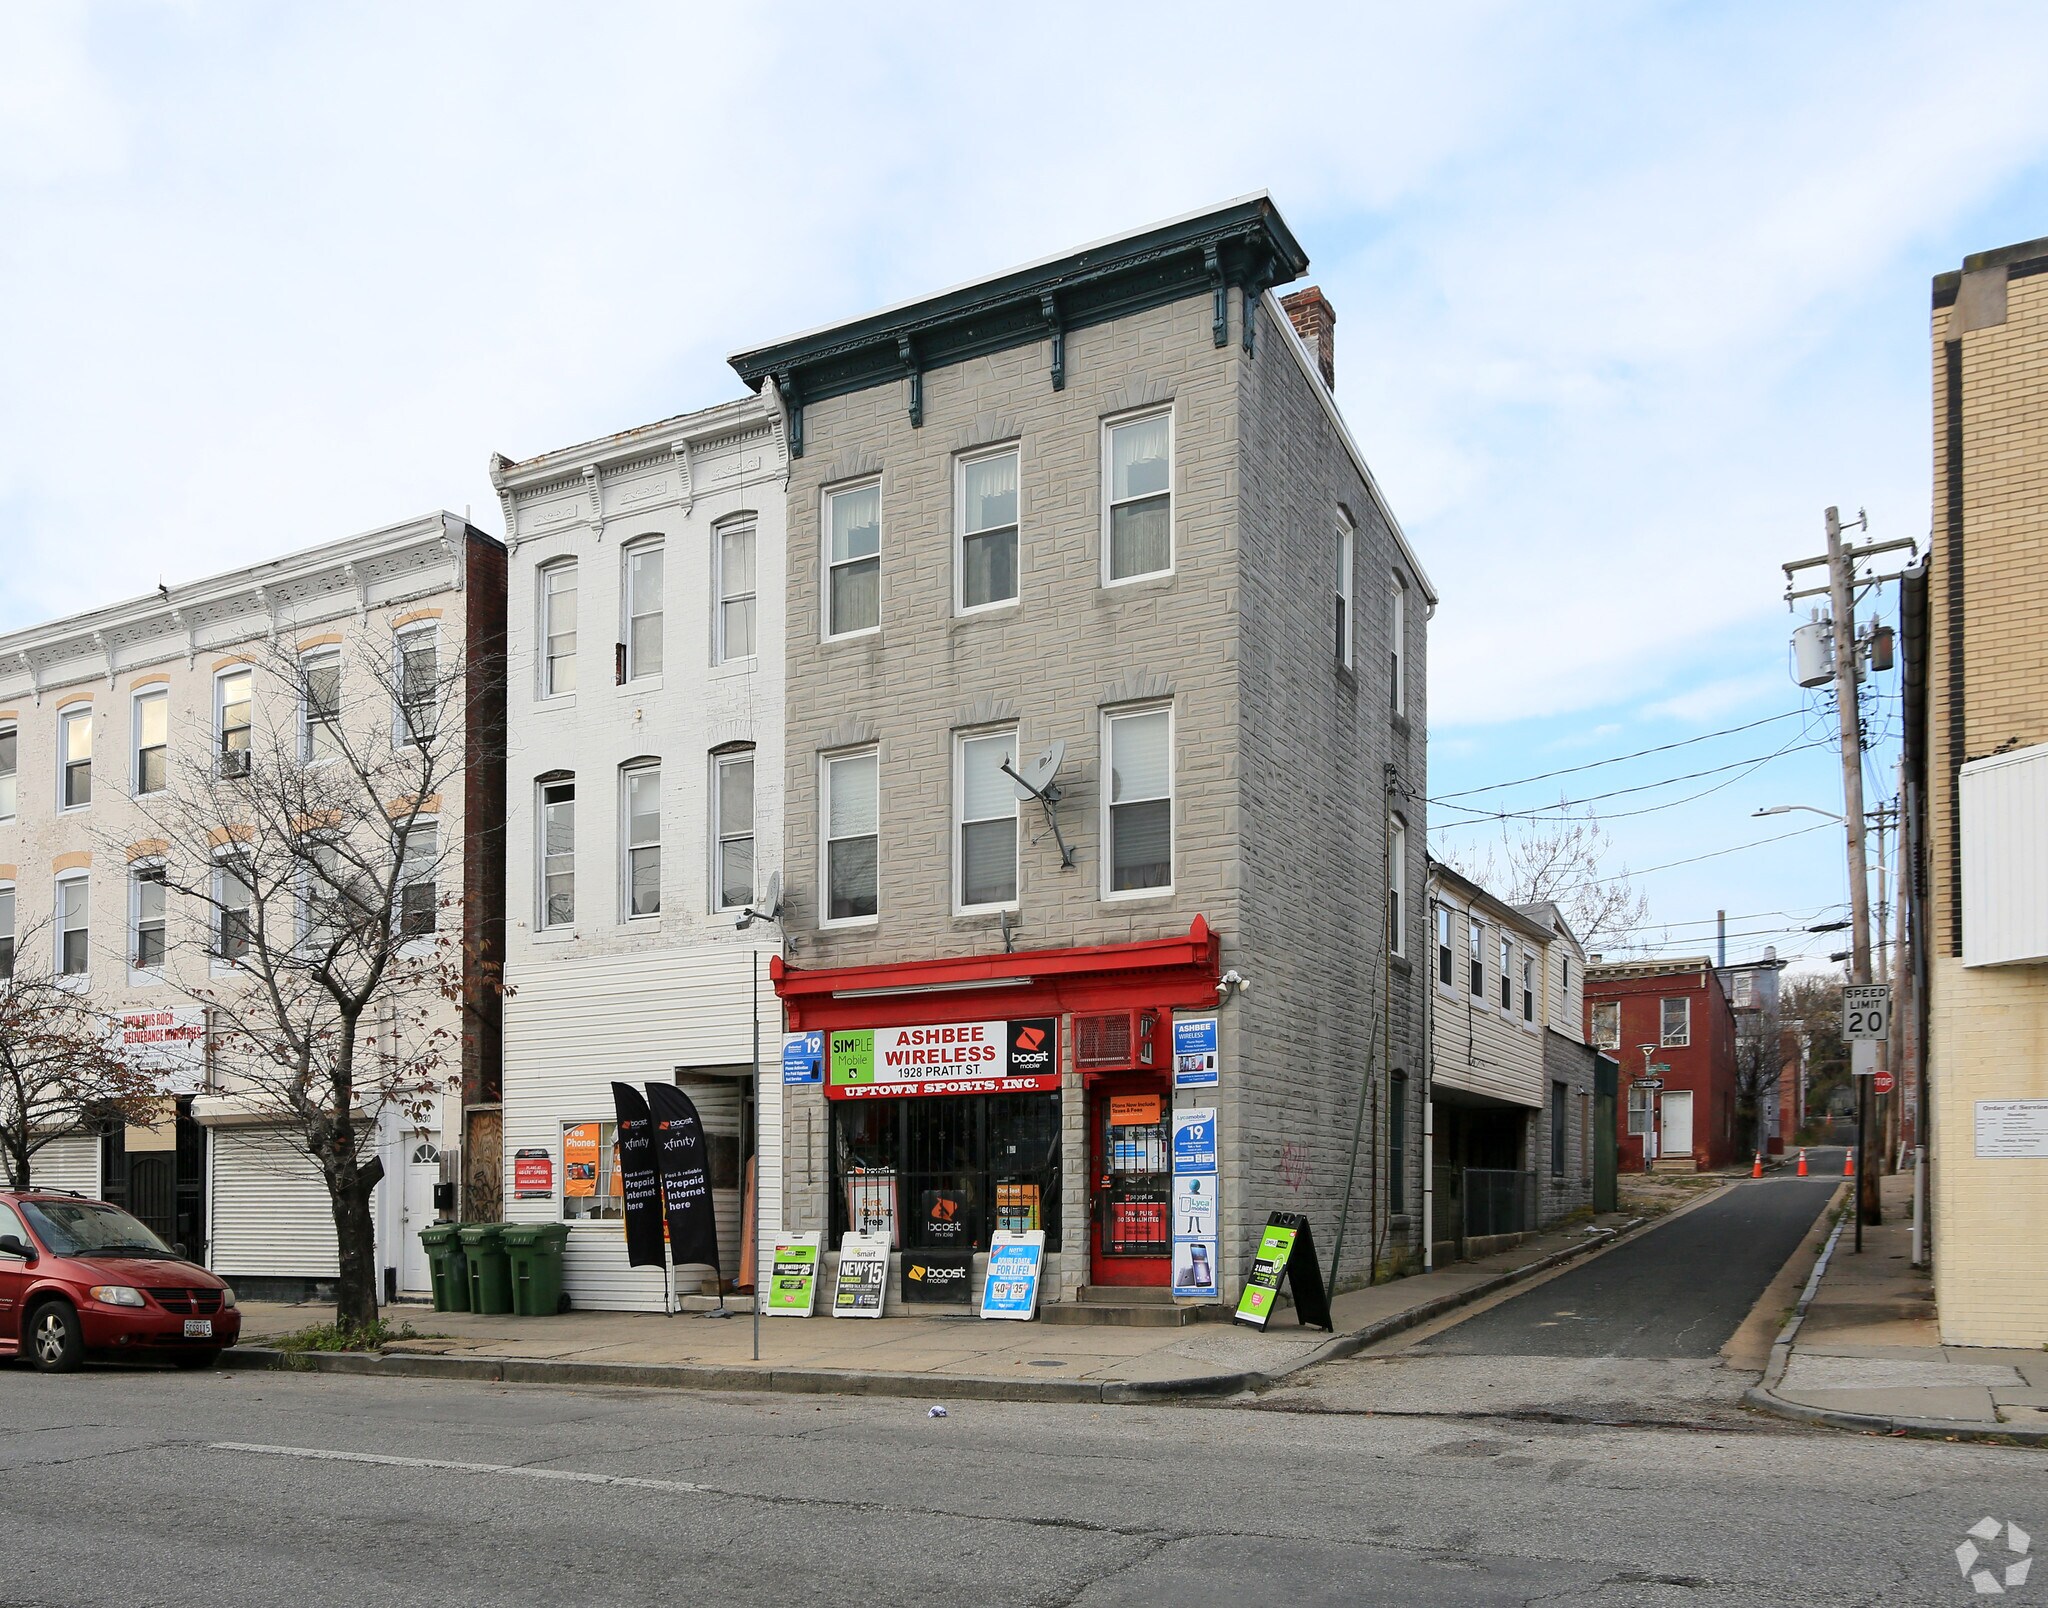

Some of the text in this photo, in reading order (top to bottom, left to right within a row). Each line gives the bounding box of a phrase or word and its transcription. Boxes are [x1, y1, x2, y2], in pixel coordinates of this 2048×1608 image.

[1846, 989, 1886, 998] SPEED
[1850, 1000, 1881, 1009] LIMIT
[141, 1014, 155, 1027] THIS
[157, 1013, 174, 1025] ROCK
[1849, 1012, 1881, 1032] 20
[1179, 1023, 1210, 1032] ASHBEE
[124, 1029, 163, 1044] DELIVERANCE
[897, 1026, 984, 1046] ASHBEE
[834, 1038, 872, 1053] SIMPLE
[839, 1055, 867, 1066] Mobile
[886, 1046, 996, 1066] WIRELESS
[1012, 1051, 1048, 1063] boost
[898, 1064, 981, 1078] 1928 PRATT ST.
[844, 1078, 1039, 1097] UPTOWN SPORTS, INC.
[1874, 1078, 1892, 1086] TOP
[630, 1119, 648, 1127] boost
[670, 1117, 694, 1127] boost
[566, 1139, 596, 1147] Phones
[625, 1137, 649, 1151] xfinity
[664, 1136, 696, 1151] xfinity
[682, 1168, 702, 1176] reliable
[625, 1176, 655, 1189] Prepaid
[666, 1175, 704, 1189] Prepaid
[626, 1188, 656, 1200] Internet
[668, 1187, 705, 1200] Internet
[627, 1202, 644, 1210] here
[670, 1201, 691, 1211] here
[1191, 1198, 1210, 1207] Lyca
[864, 1217, 883, 1226] Free
[928, 1221, 961, 1231] boost
[841, 1262, 882, 1283] NEW $15
[928, 1266, 965, 1278] boost
[996, 1265, 1029, 1275] FOR LIFE!
